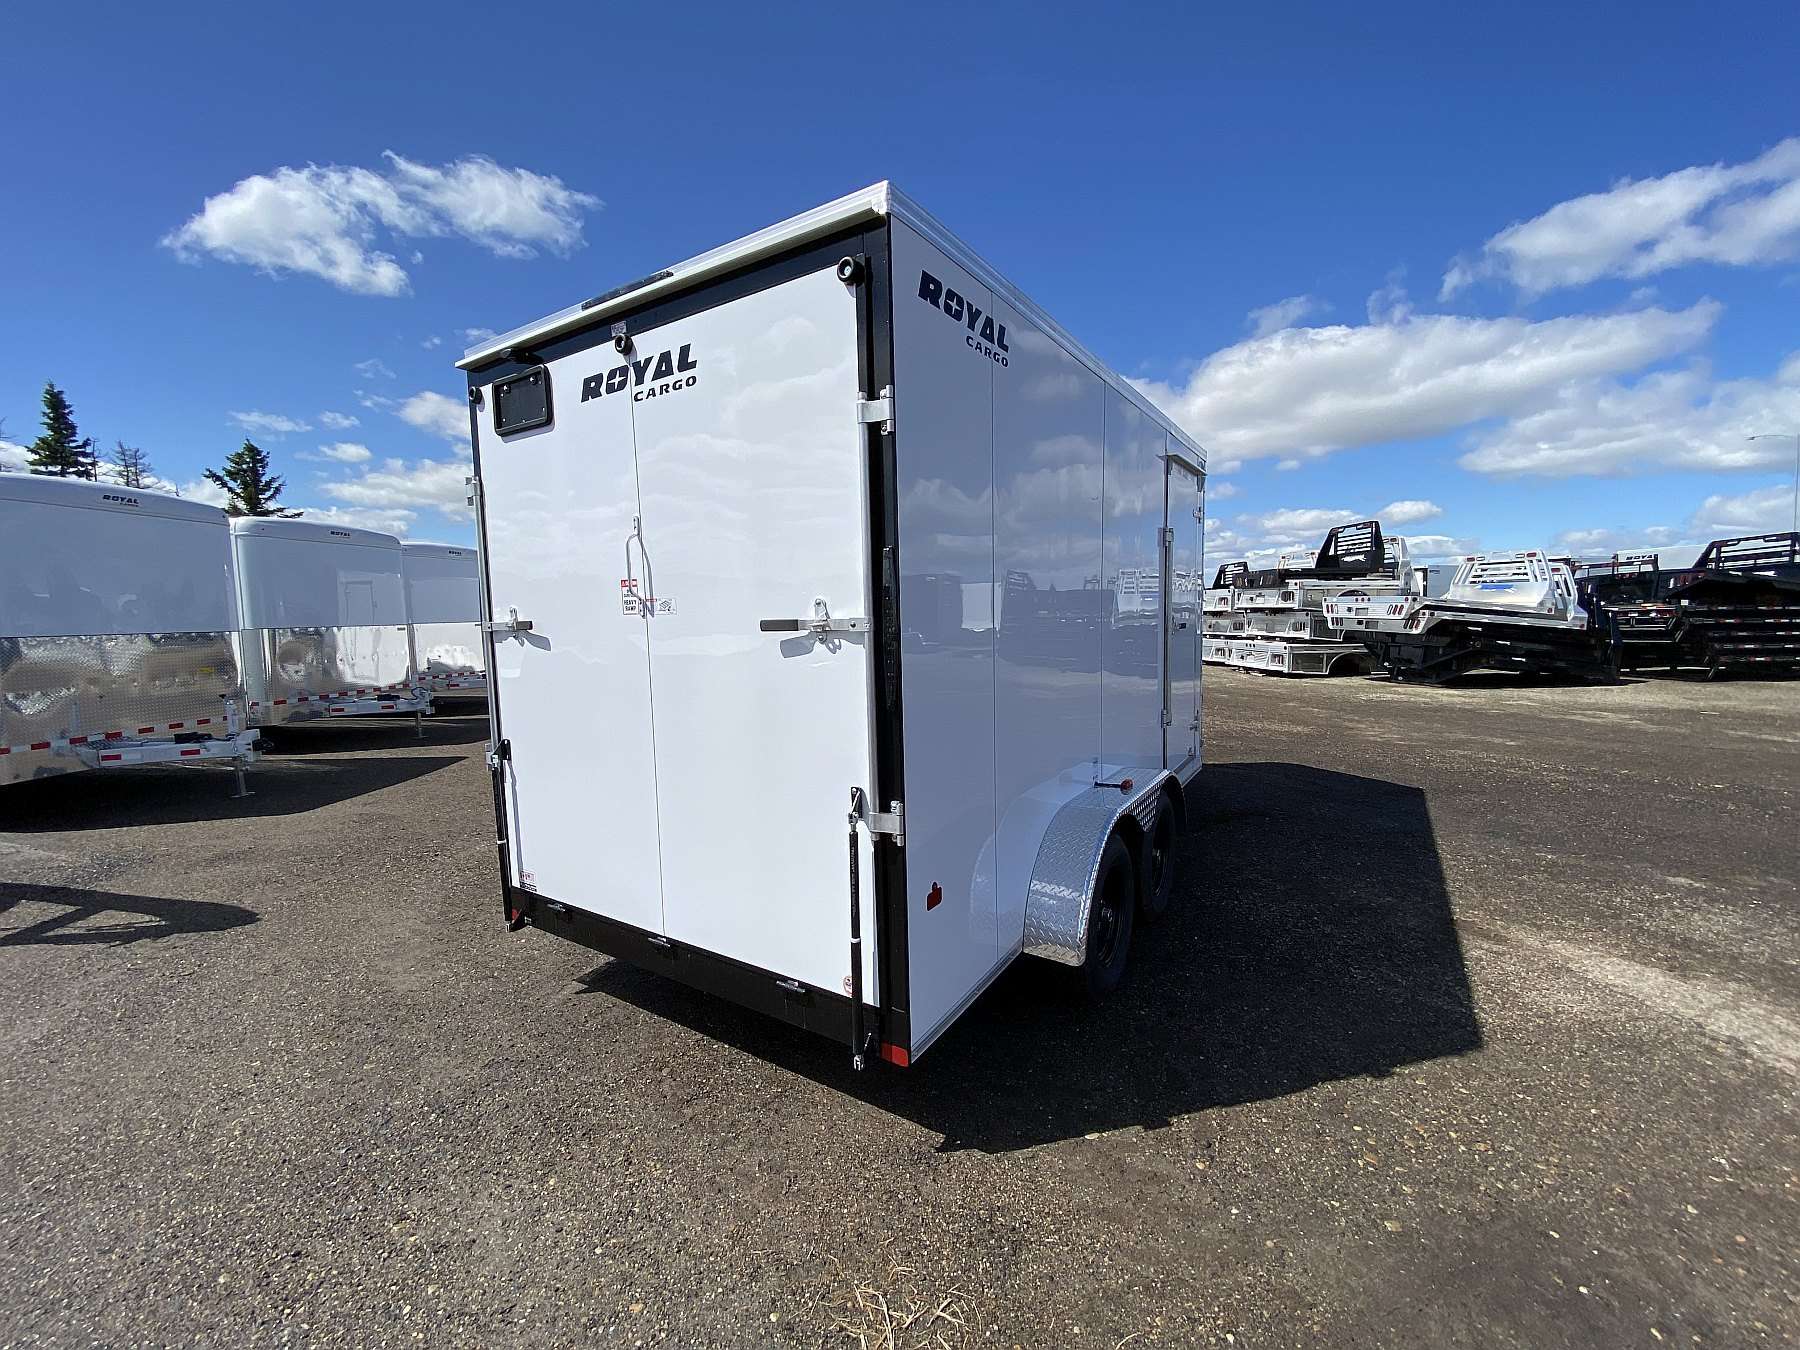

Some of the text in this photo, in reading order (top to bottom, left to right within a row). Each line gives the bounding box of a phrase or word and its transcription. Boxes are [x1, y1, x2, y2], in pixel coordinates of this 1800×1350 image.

[918, 269, 1009, 353] ROYAL
[965, 335, 1009, 368] CARGO
[581, 343, 698, 403] ROYAL
[633, 375, 697, 402] CARGO
[102, 494, 139, 505] ROYAL
